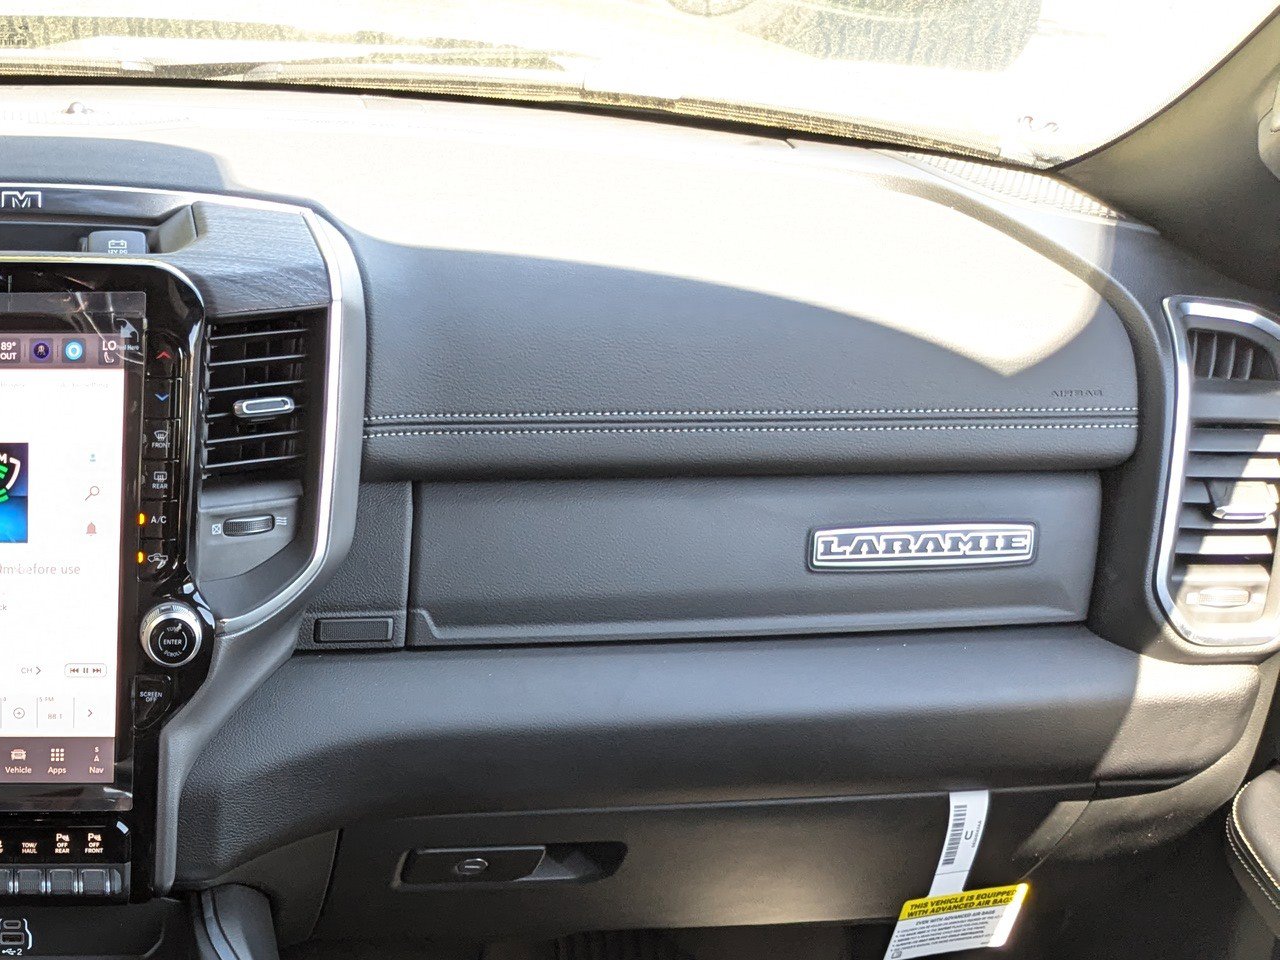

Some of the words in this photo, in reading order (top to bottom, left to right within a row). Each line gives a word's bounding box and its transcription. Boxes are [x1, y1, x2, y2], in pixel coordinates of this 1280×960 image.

[0, 341, 17, 351] 89°
[102, 340, 117, 351] LO
[150, 515, 167, 524] A/C
[819, 532, 1030, 558] LARAMIE
[17, 564, 57, 575] before
[61, 566, 81, 575] use
[5, 766, 32, 774] Vehicle
[47, 766, 67, 775] Apps
[89, 766, 104, 774] Nav
[910, 902, 929, 910] THIS
[930, 896, 964, 907] VEHICLE
[976, 889, 1017, 901] EQUIPPED
[907, 907, 928, 918] WITH
[929, 902, 975, 914] ADVANCED
[992, 897, 1013, 905] BAGS
